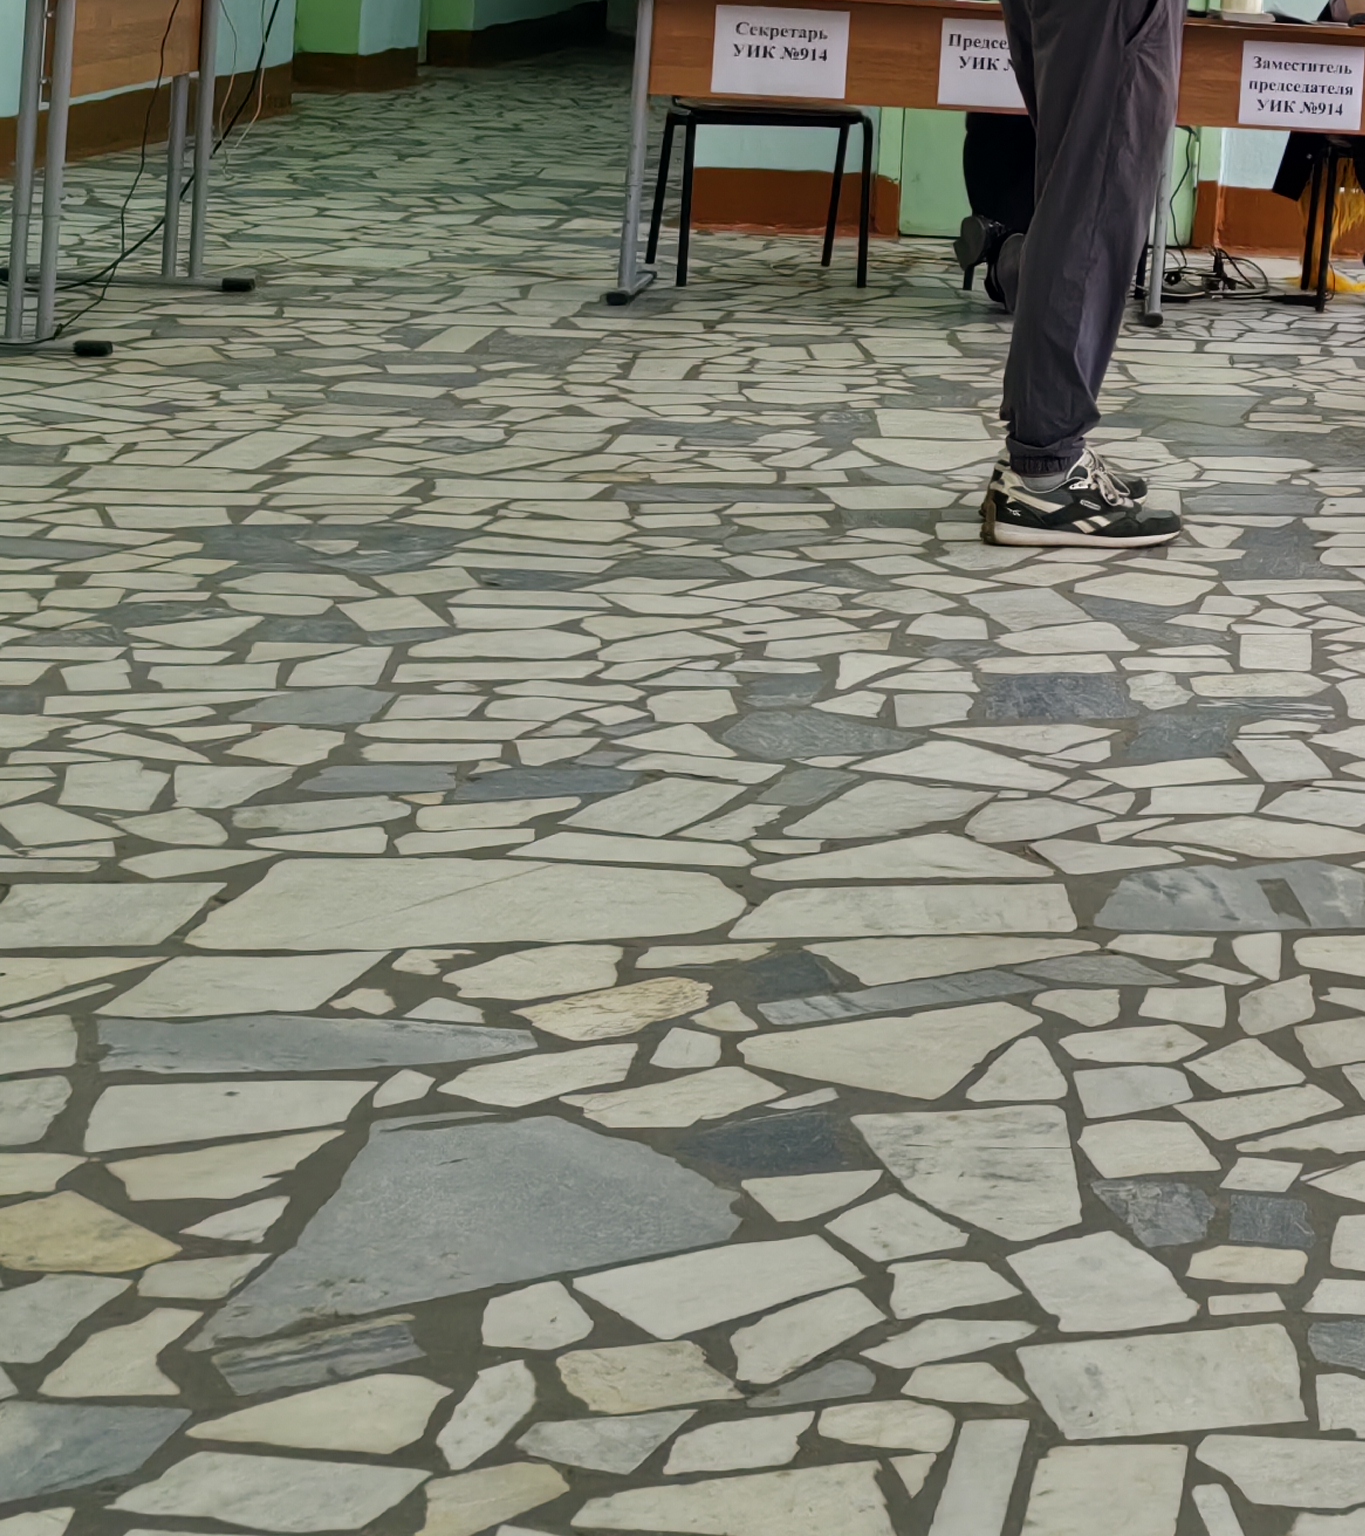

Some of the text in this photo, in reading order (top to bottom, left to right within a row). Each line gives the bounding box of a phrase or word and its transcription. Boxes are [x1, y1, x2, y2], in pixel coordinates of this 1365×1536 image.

[735, 21, 828, 42] Секретарь
[948, 33, 1010, 51] Предсе
[733, 44, 828, 62] УИК №914
[959, 55, 1000, 71] УИК
[1253, 55, 1353, 74] Заместитель
[1249, 80, 1353, 96] председателя
[1257, 99, 1343, 116] УИК №914
